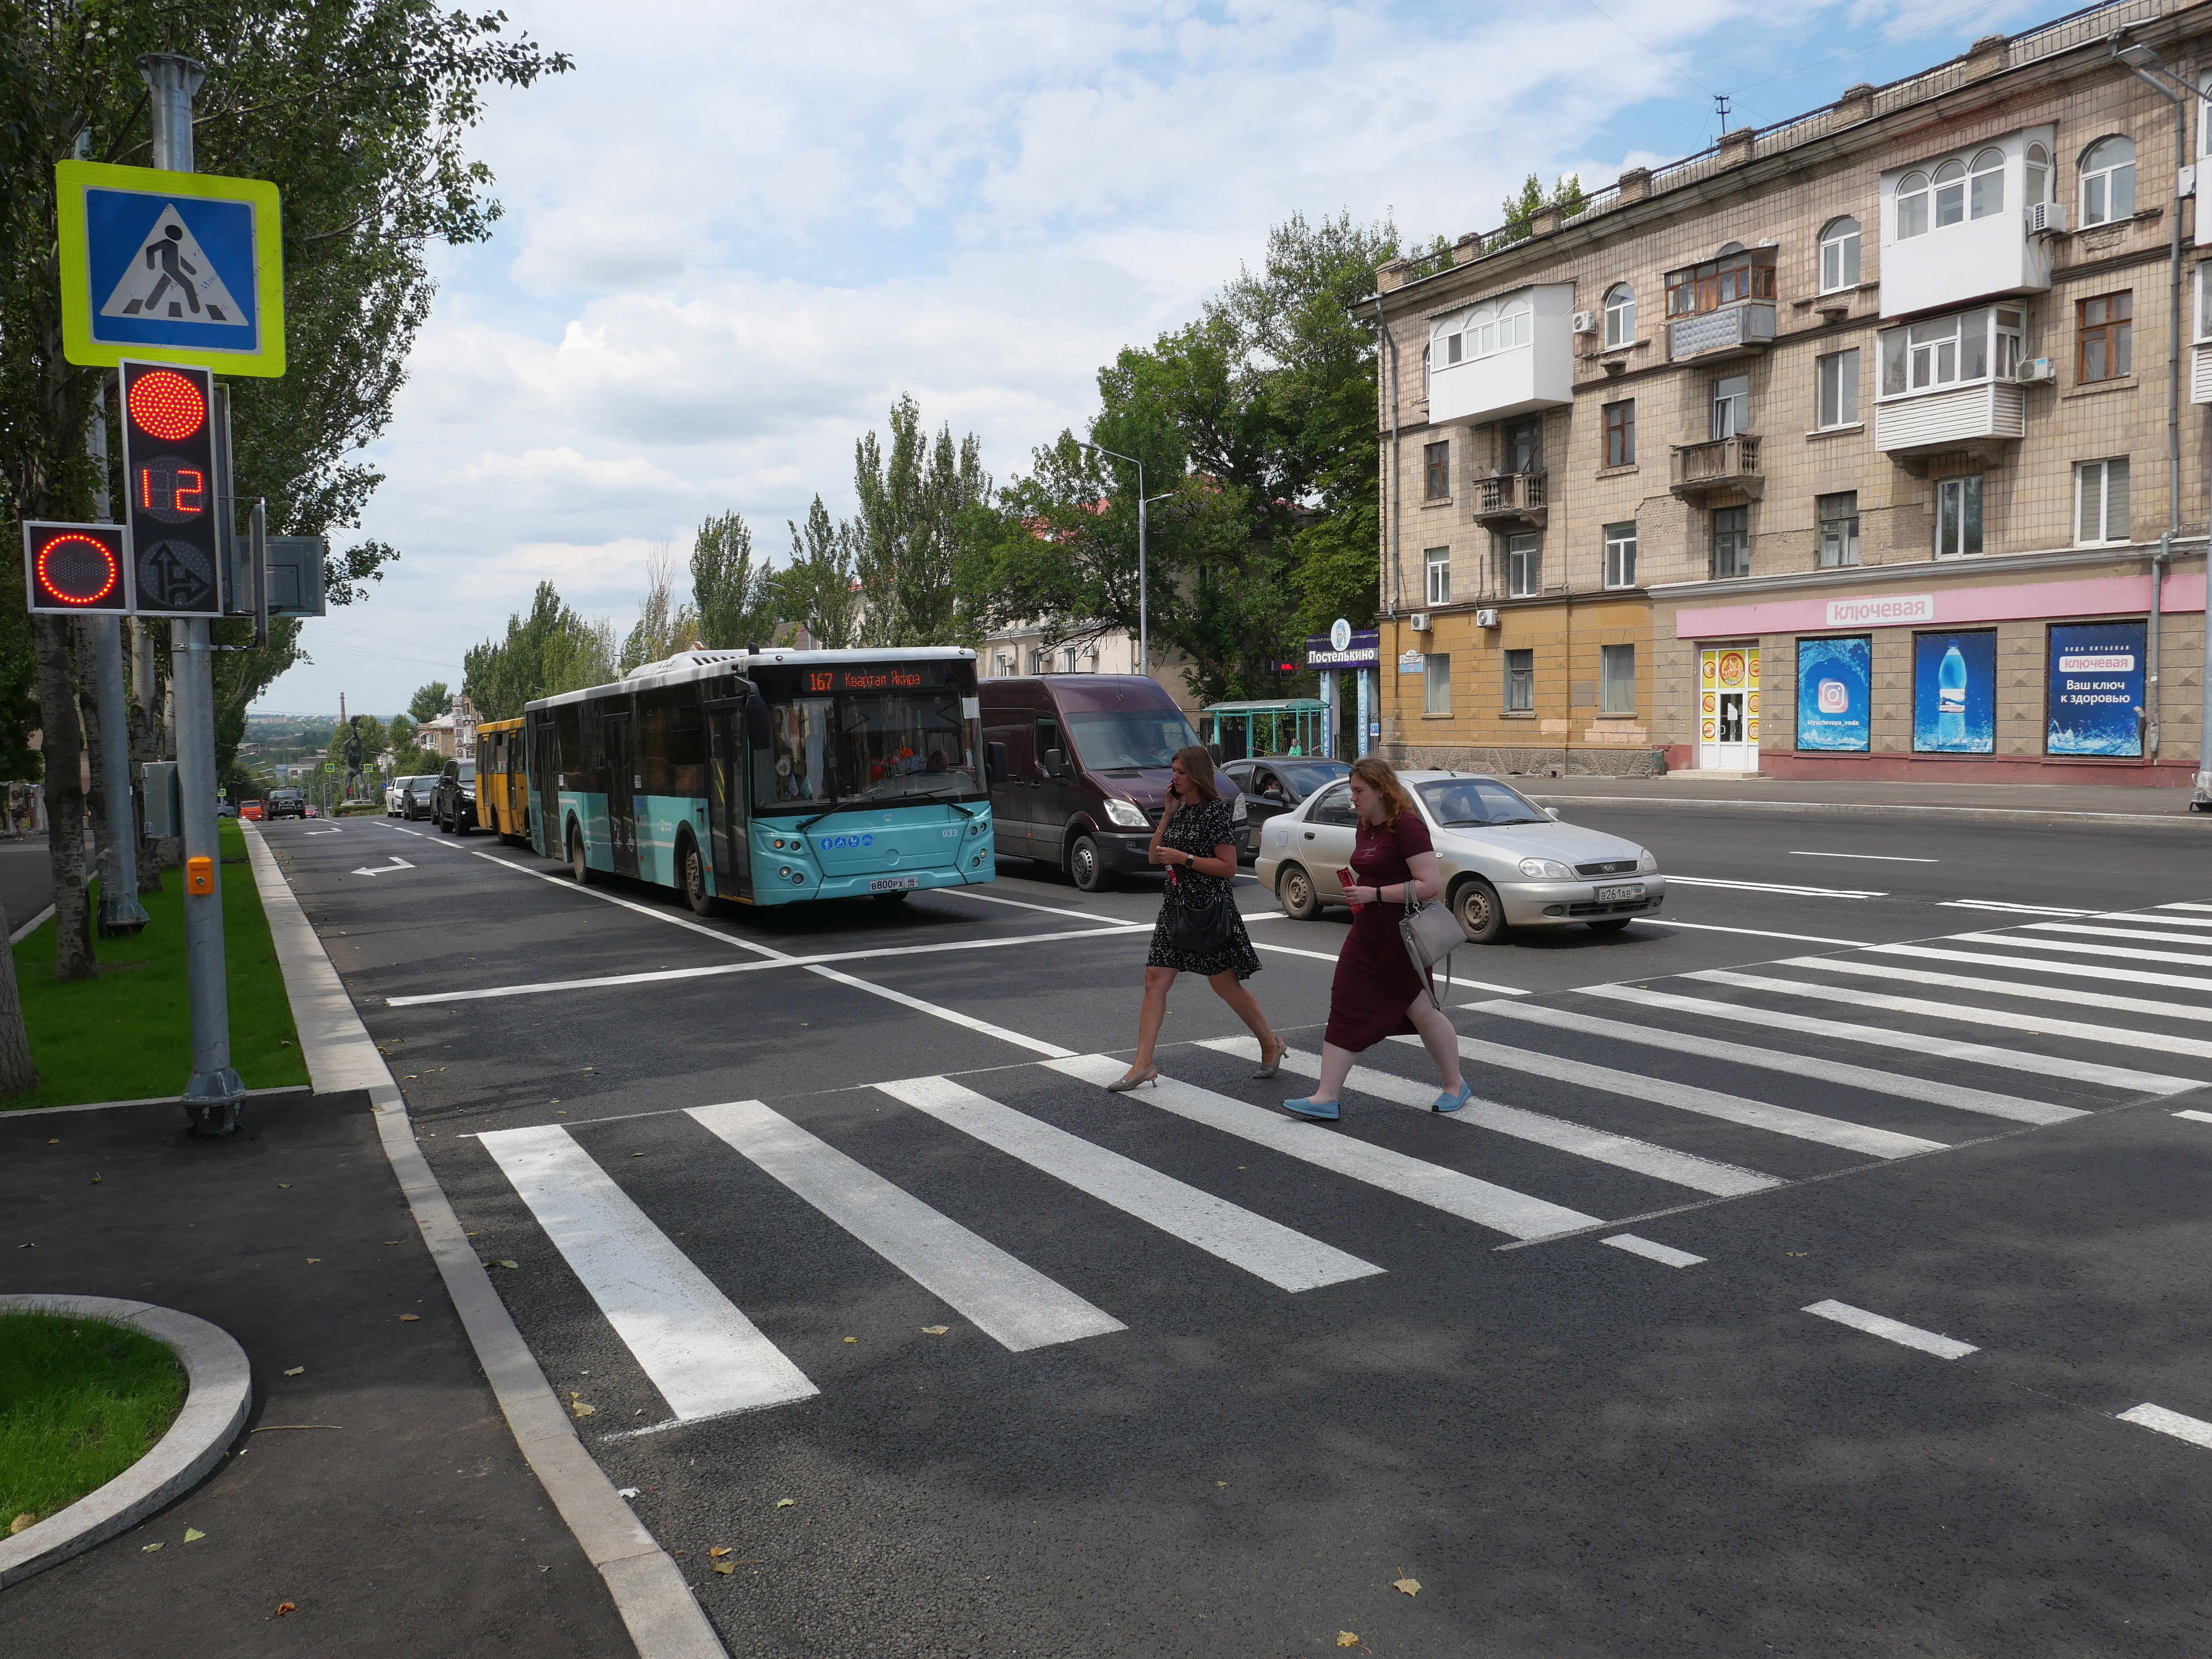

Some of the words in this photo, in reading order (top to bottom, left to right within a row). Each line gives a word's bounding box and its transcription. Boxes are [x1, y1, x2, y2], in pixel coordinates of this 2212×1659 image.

[143, 469, 202, 511] 12
[1834, 601, 1925, 621] ключевая
[1310, 649, 1374, 663] Постелькино
[2065, 659, 2128, 669] ключевая
[811, 673, 832, 690] 167
[845, 672, 886, 688] Квартал
[891, 670, 920, 686] Якира
[2066, 680, 2090, 690] Ваш
[2070, 695, 2130, 705] здоровью
[942, 829, 958, 837] 033
